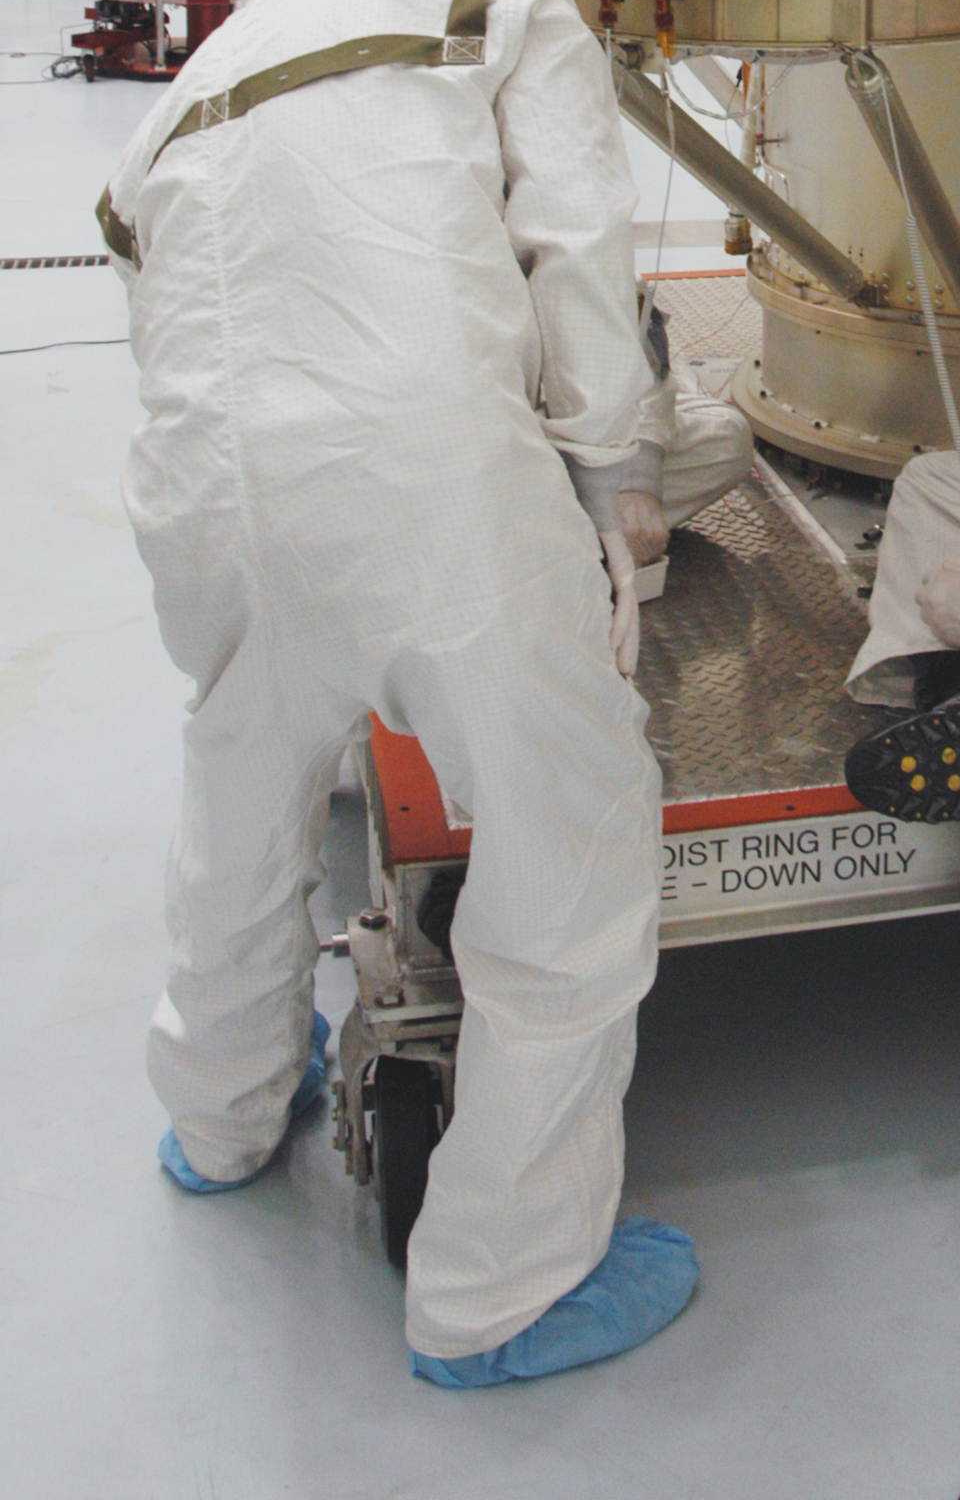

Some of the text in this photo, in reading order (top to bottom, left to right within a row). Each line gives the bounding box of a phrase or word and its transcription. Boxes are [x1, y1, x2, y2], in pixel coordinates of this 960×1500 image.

[742, 830, 819, 860] RING
[832, 821, 898, 850] FOR
[721, 859, 821, 893] DOWN
[834, 849, 917, 881] ONLY
